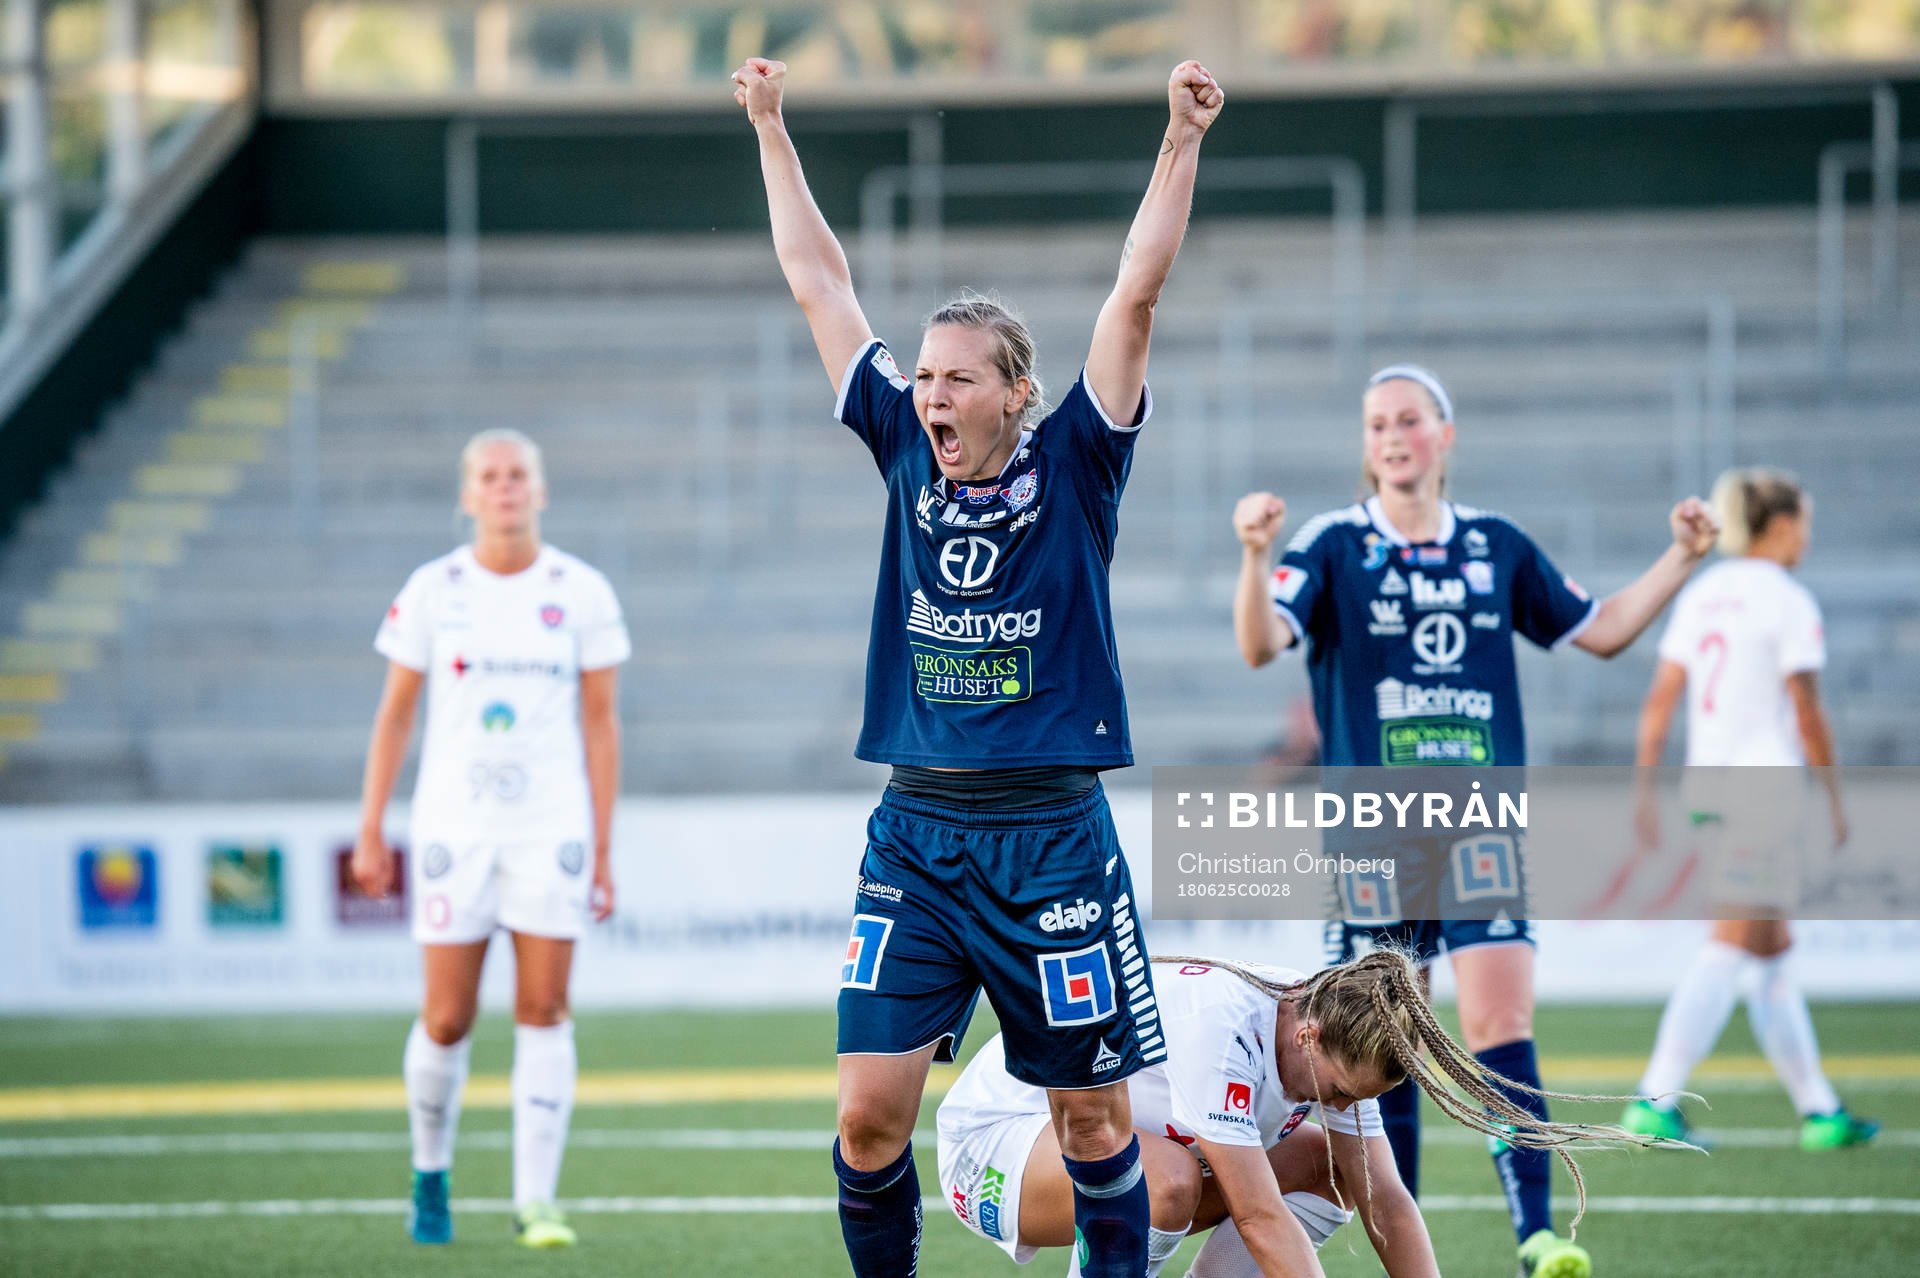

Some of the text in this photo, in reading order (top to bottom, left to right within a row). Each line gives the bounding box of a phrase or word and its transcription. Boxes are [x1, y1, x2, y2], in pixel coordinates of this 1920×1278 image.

[930, 605, 1041, 642] Botrygg
[914, 653, 1018, 677] GRÖNSAKS
[934, 675, 1003, 696] HUSET
[1038, 898, 1102, 932] elajo
[1092, 1058, 1121, 1074] SELECT
[1208, 1112, 1246, 1125] SVENSKA
